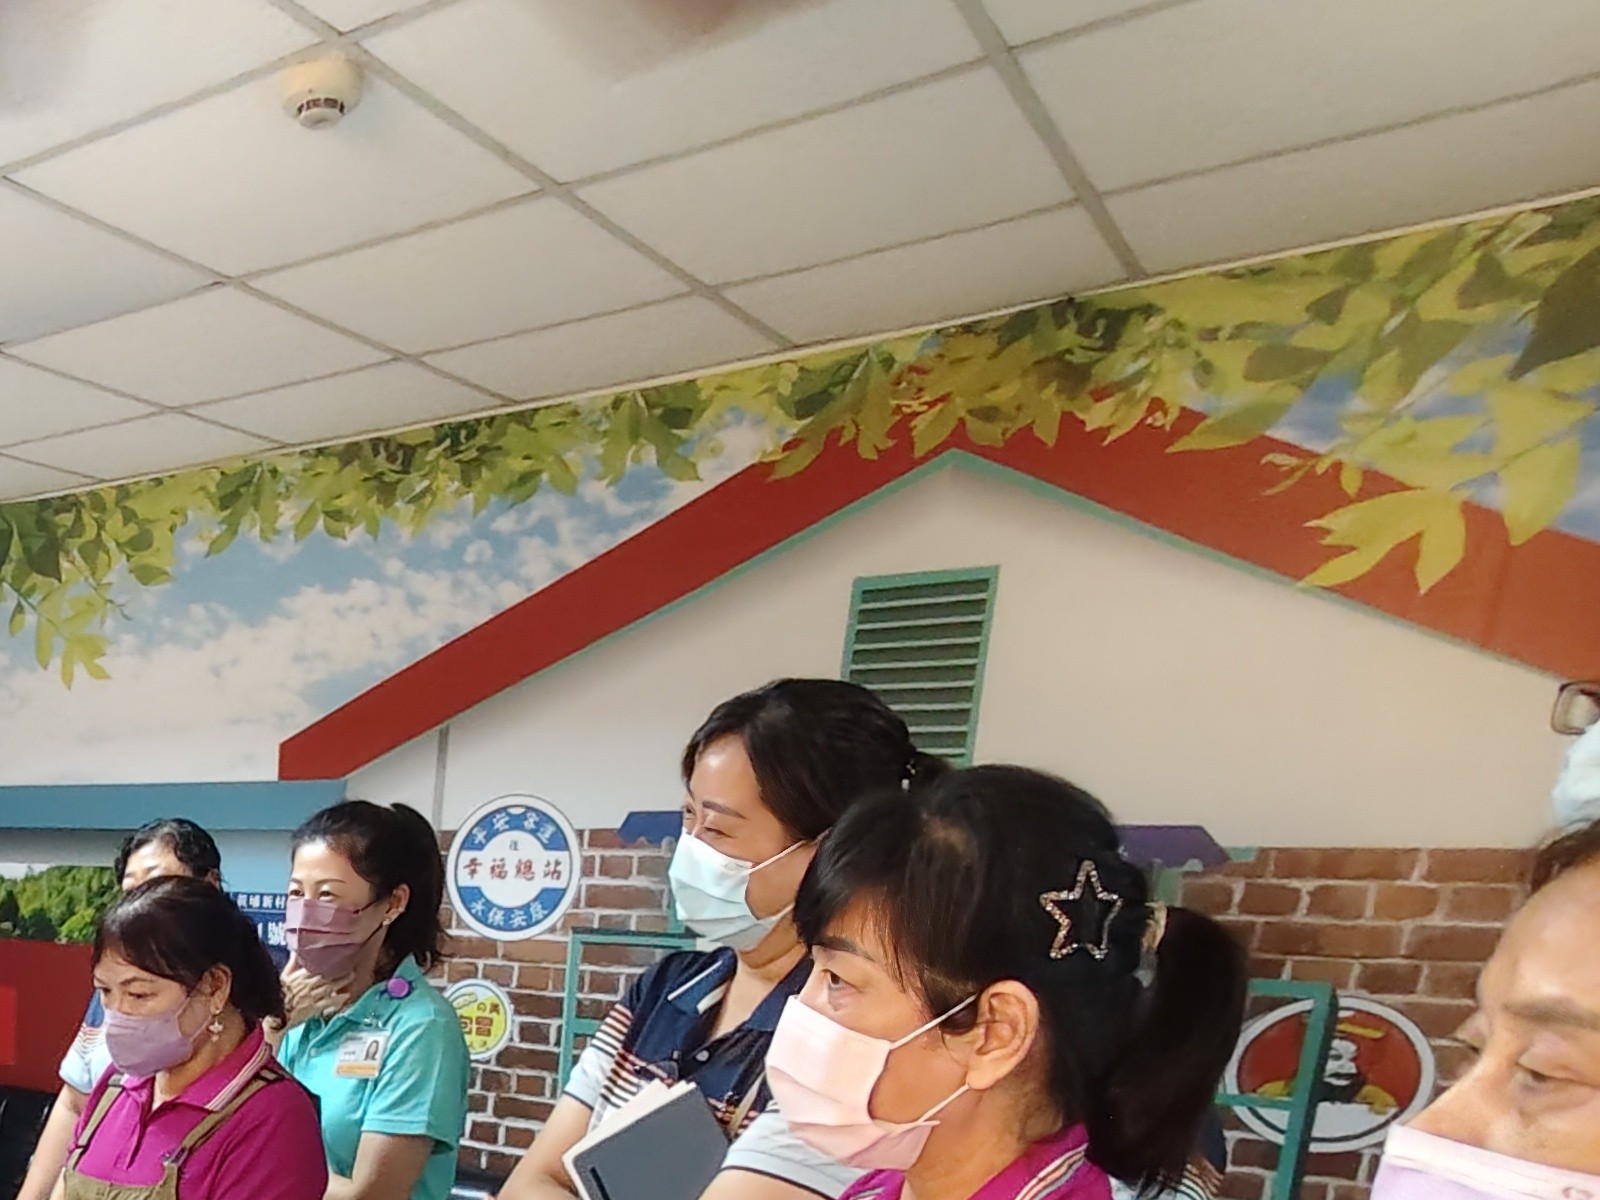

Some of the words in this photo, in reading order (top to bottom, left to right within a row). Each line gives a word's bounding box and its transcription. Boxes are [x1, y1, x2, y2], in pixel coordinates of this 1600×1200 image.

[463, 857, 563, 882] 幸福總站
[470, 897, 549, 928] 永保安康
